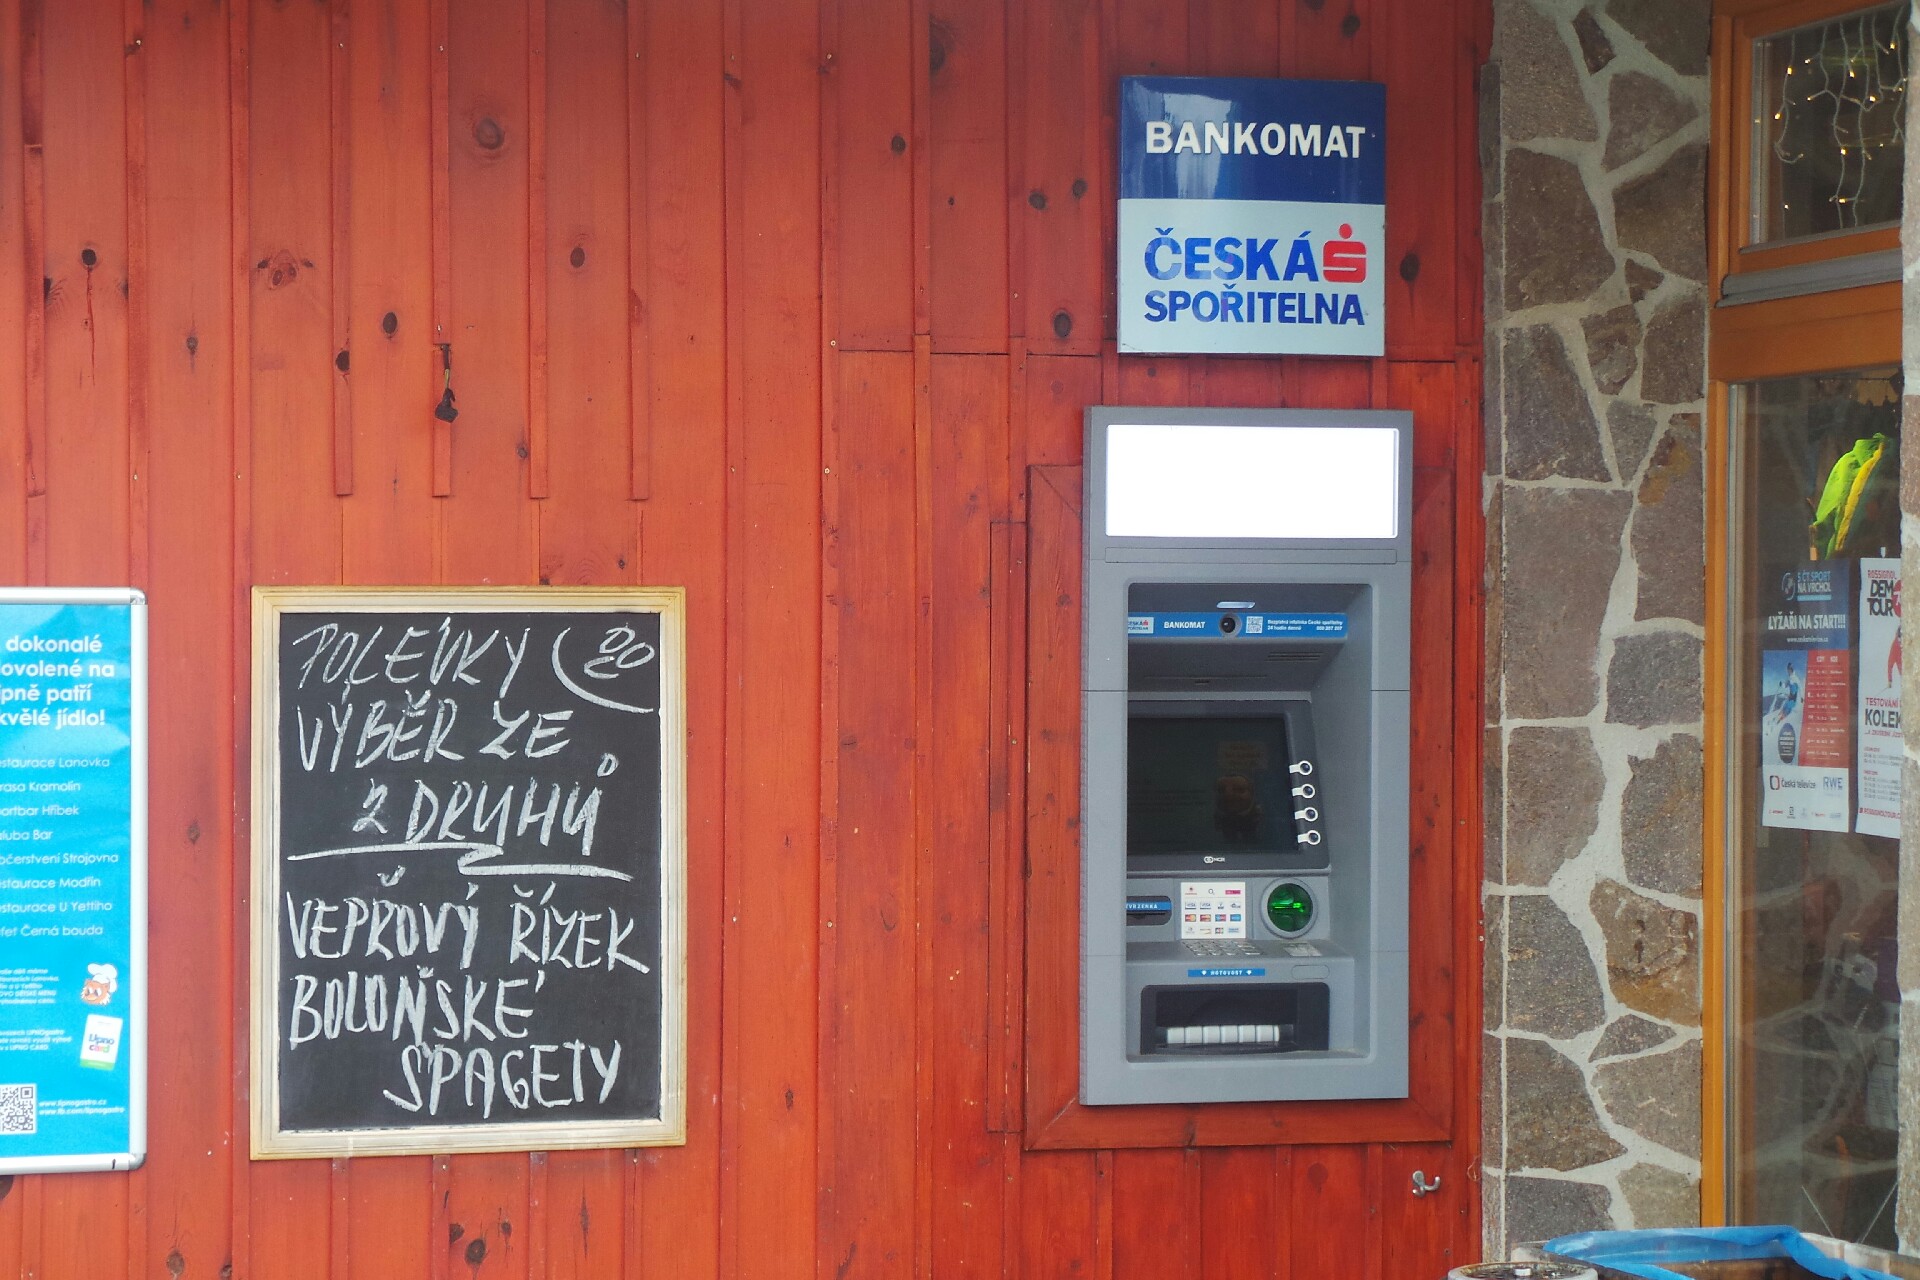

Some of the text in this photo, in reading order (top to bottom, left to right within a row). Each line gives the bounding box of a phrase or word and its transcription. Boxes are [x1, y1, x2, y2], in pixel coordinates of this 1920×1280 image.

[1145, 121, 1366, 159] BANKOMAT
[1143, 227, 1320, 282] ČESKÁ
[1144, 283, 1366, 326] SPOŘITELNA
[1811, 570, 1831, 582] SPORT
[1797, 581, 1831, 593] NA VRCHOL
[1866, 597, 1894, 617] TOUR
[1163, 621, 1206, 629] BANKOMAT
[1768, 612, 1846, 630] LYŽAŘI NA START!!!
[5, 634, 103, 653] dokonalé
[0, 658, 115, 677] ovolené na
[46, 682, 93, 705] patří
[1865, 696, 1899, 709] TESTOVÁNÍ
[55, 707, 105, 730] jídlo!
[298, 681, 574, 773] VÝBĚR ZE
[0, 757, 110, 768] staurace Lanovka
[29, 780, 81, 792] Kramolín
[1781, 776, 1796, 789] Česká
[1823, 776, 1843, 791] RWE
[0, 803, 79, 816] ortbar Hříbek
[353, 753, 619, 856] 2 DRUHŮ
[33, 829, 53, 840] Bar
[62, 852, 119, 866] Strojovna
[0, 878, 55, 889] staurace
[0, 902, 55, 914] staurace
[59, 902, 67, 912] U
[287, 865, 651, 973] VEPŘOVÝ ŘÍZEK
[20, 923, 59, 936] Černá
[62, 924, 104, 936] bouda
[89, 1044, 110, 1053] card
